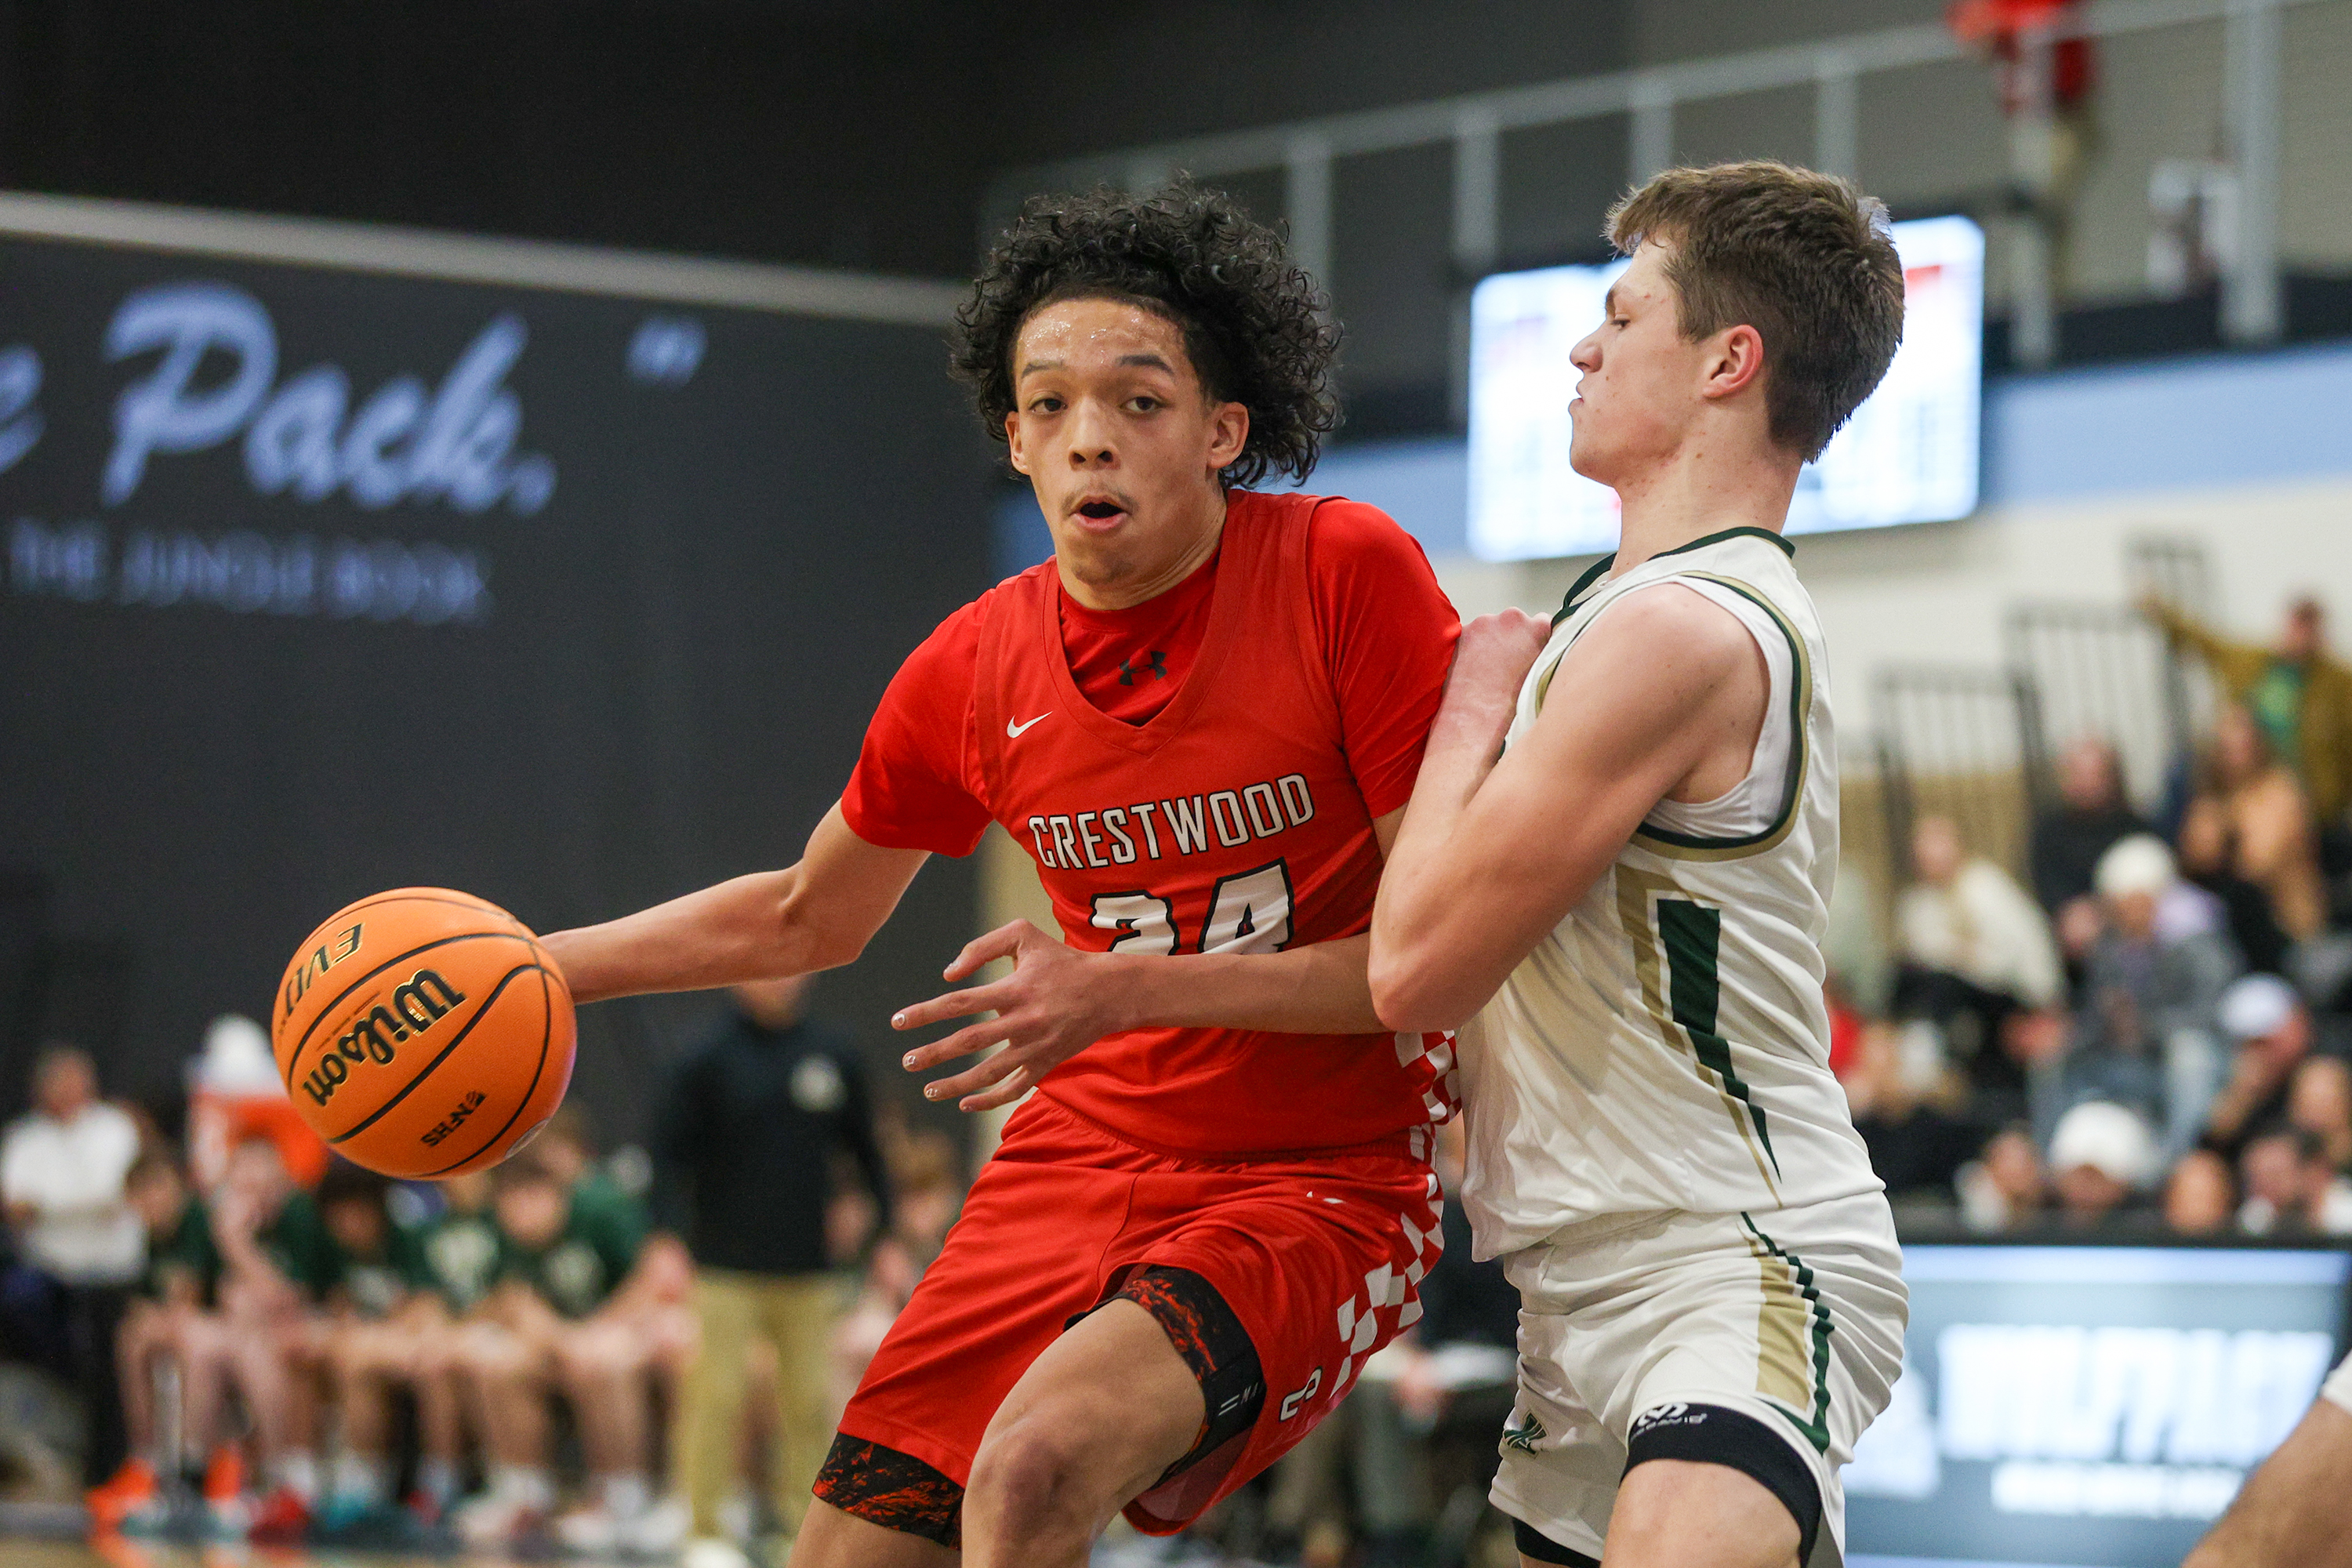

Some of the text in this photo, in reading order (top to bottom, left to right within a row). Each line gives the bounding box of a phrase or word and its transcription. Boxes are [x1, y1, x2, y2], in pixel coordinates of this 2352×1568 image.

[1027, 773, 1315, 869] CRESTWOOD
[302, 968, 468, 1106] Wilson
[420, 1102, 474, 1147] NFHS
